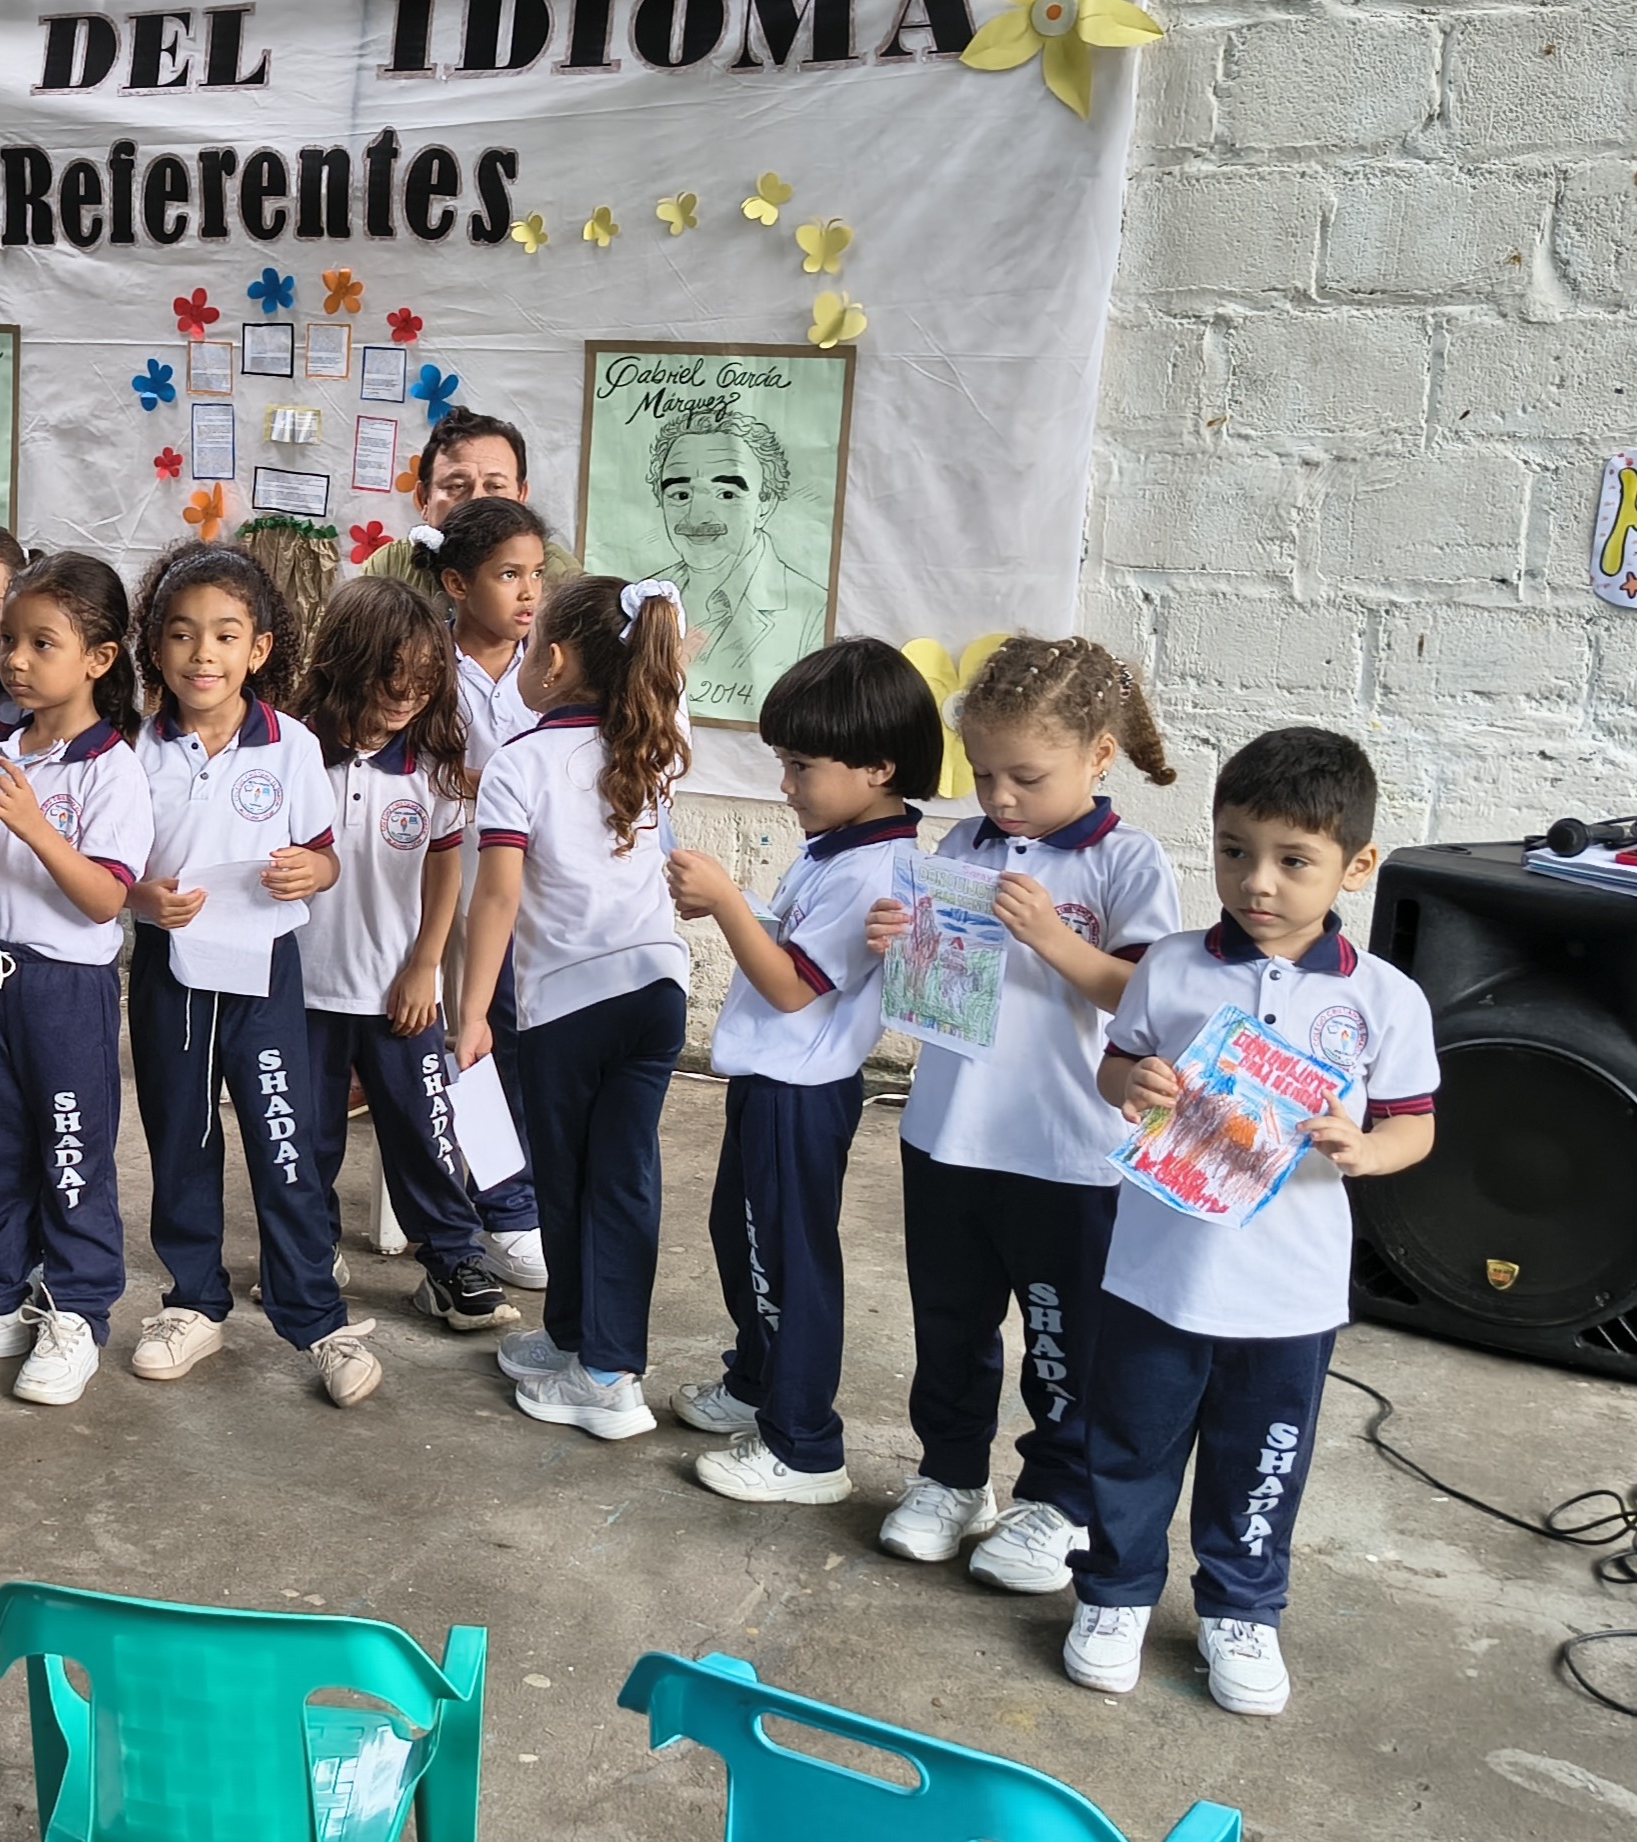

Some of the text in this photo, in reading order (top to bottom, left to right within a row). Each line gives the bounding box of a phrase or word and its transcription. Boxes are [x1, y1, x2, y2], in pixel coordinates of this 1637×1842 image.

[30, 1, 272, 97] DEL
[377, 0, 981, 81] IDIOMA
[0, 126, 519, 250] Referentes
[596, 356, 706, 399] Gabriel
[53, 1091, 87, 1210] SHADAI
[257, 1048, 300, 1185] SHADAI
[421, 1053, 458, 1176] SHADAI
[1240, 1422, 1300, 1557] SHADAI
